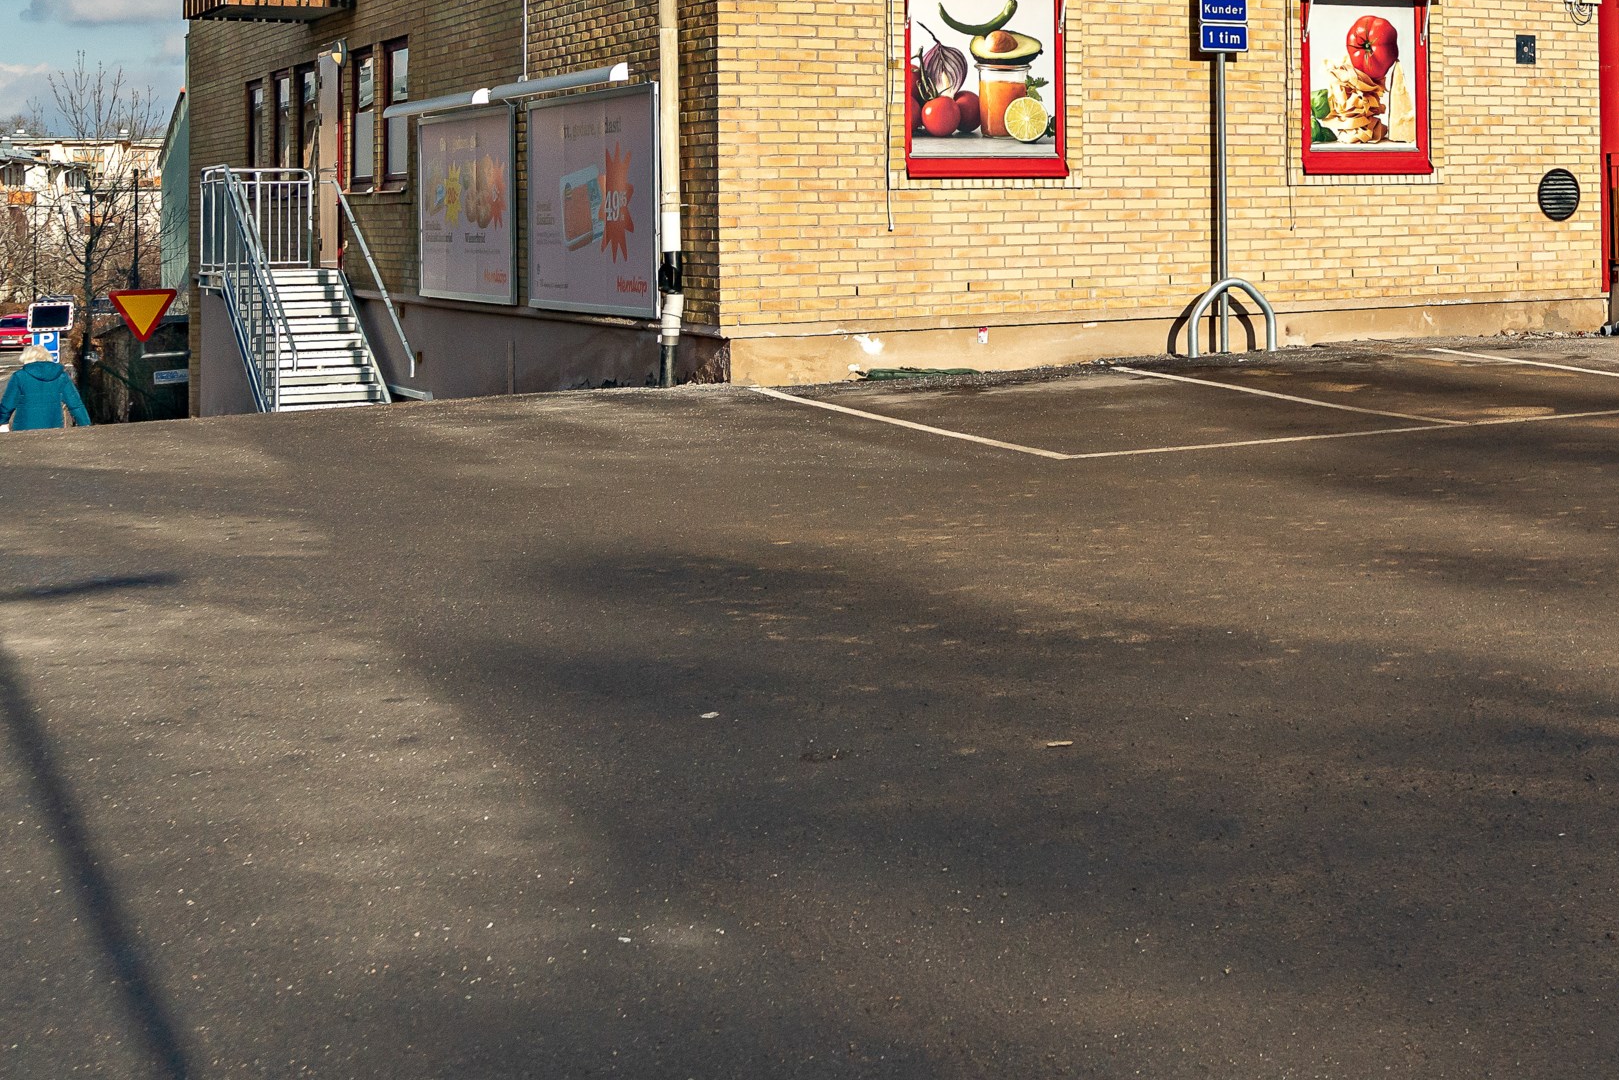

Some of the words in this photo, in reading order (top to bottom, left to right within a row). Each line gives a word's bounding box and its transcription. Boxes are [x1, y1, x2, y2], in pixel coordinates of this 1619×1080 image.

[1204, 3, 1244, 15] Kunder
[1208, 31, 1214, 44] 1
[1219, 31, 1241, 45] tim
[617, 276, 648, 297] Hemköp
